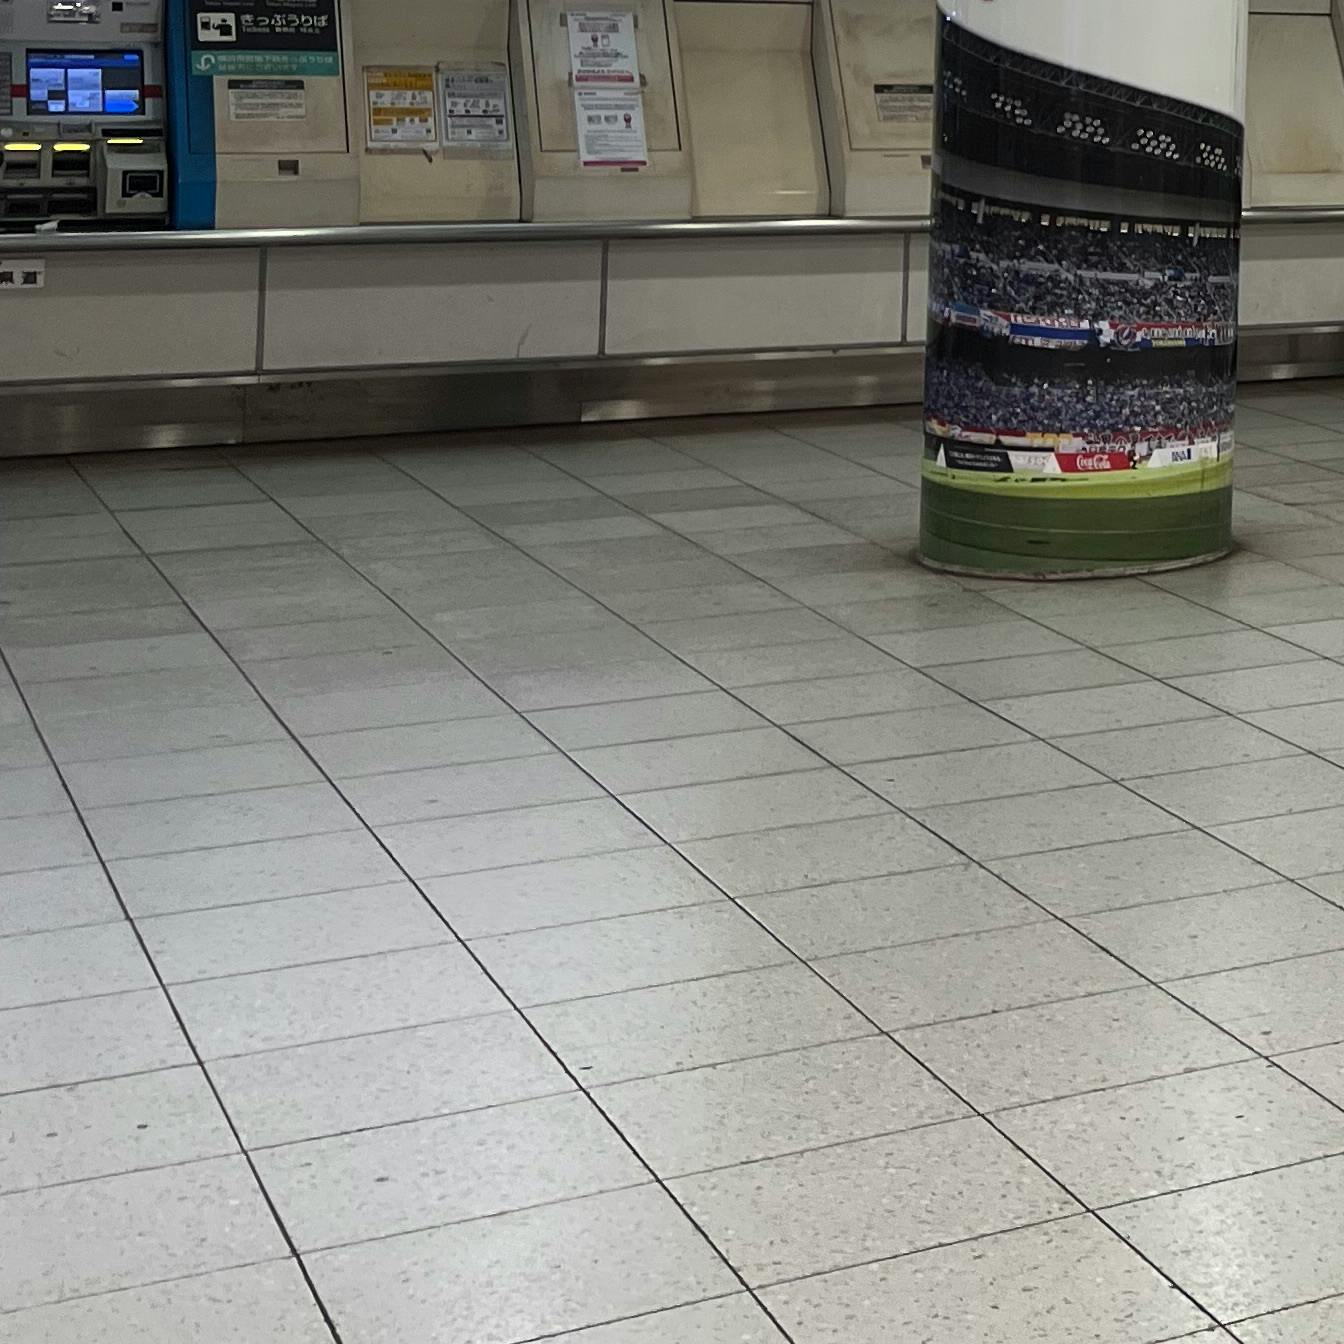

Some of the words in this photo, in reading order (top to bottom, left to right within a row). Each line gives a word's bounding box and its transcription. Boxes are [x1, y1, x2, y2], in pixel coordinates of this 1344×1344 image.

[240, 14, 328, 28] きっぷうりば
